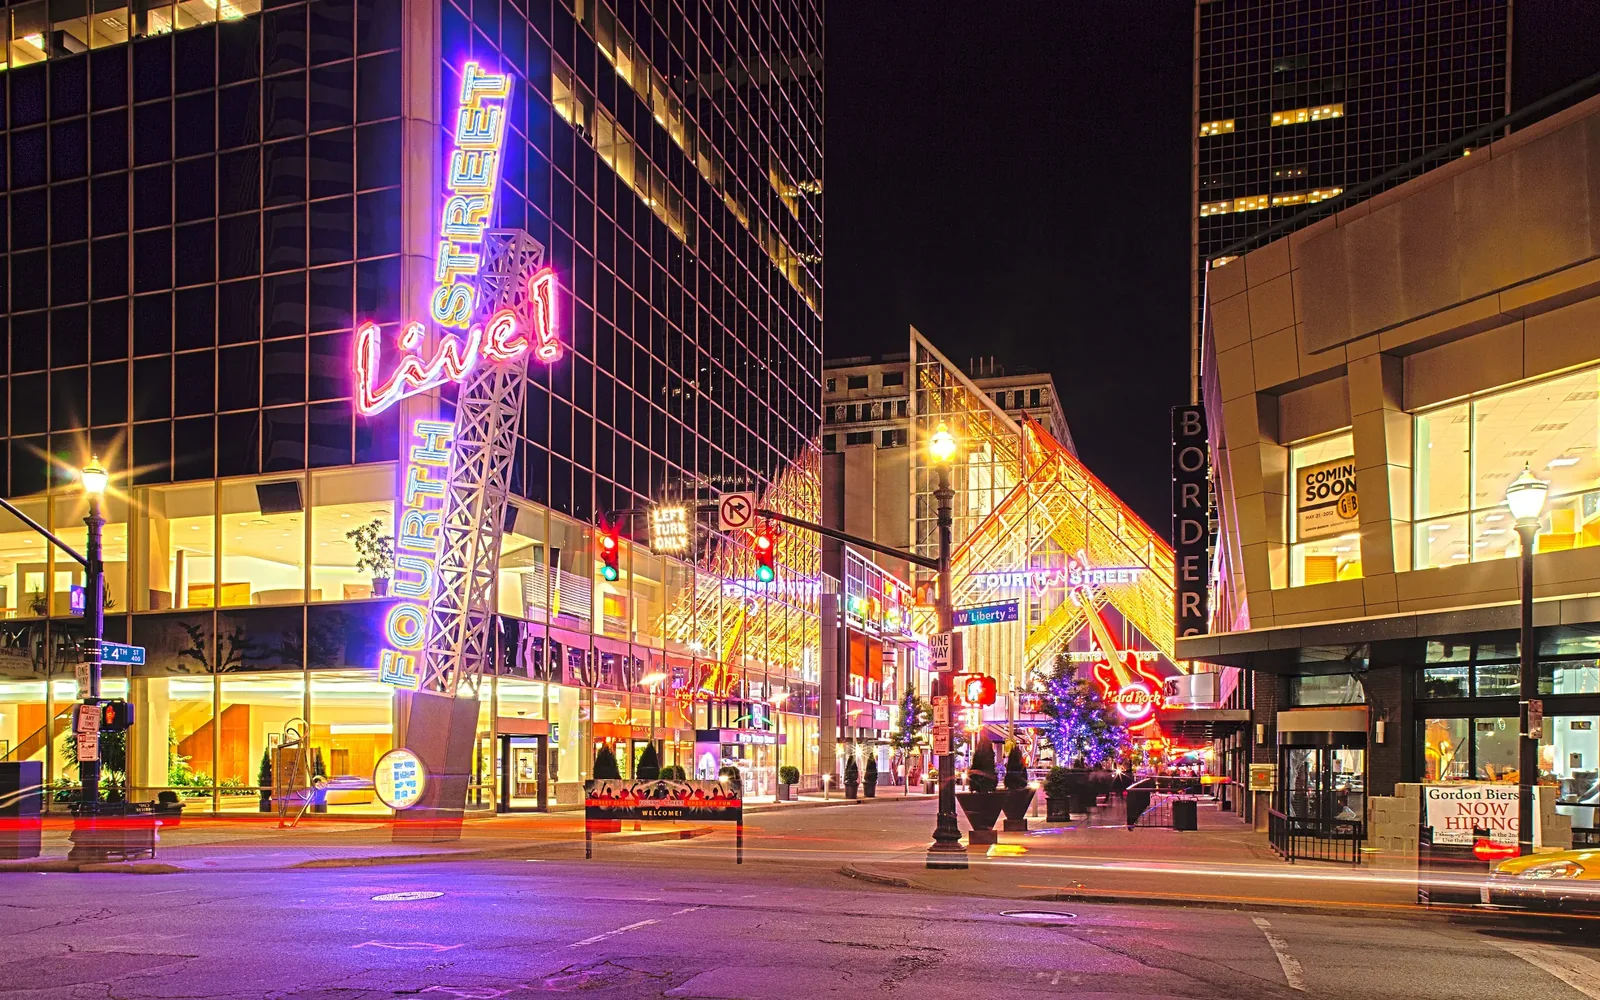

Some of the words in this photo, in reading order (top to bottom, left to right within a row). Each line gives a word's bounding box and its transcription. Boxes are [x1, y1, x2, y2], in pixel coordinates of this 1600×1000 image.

[354, 267, 562, 416] Live!
[379, 420, 455, 690] FOURTH
[432, 61, 508, 329] STREET
[1305, 476, 1357, 502] SOON
[653, 508, 686, 521] LEFT
[655, 522, 686, 535] TURN
[655, 537, 687, 550] ONLY
[975, 571, 1047, 589] FOURTH
[1069, 569, 1139, 585] STREET
[958, 613, 968, 623] W
[971, 610, 1006, 622] Liberty
[931, 634, 949, 647] ONE
[111, 647, 128, 660] 4TH
[931, 646, 949, 659] WAY
[1134, 690, 1162, 706] Rock
[1429, 788, 1482, 801] Gordon
[1456, 802, 1510, 816] NOW
[1445, 816, 1520, 831] HIRING
